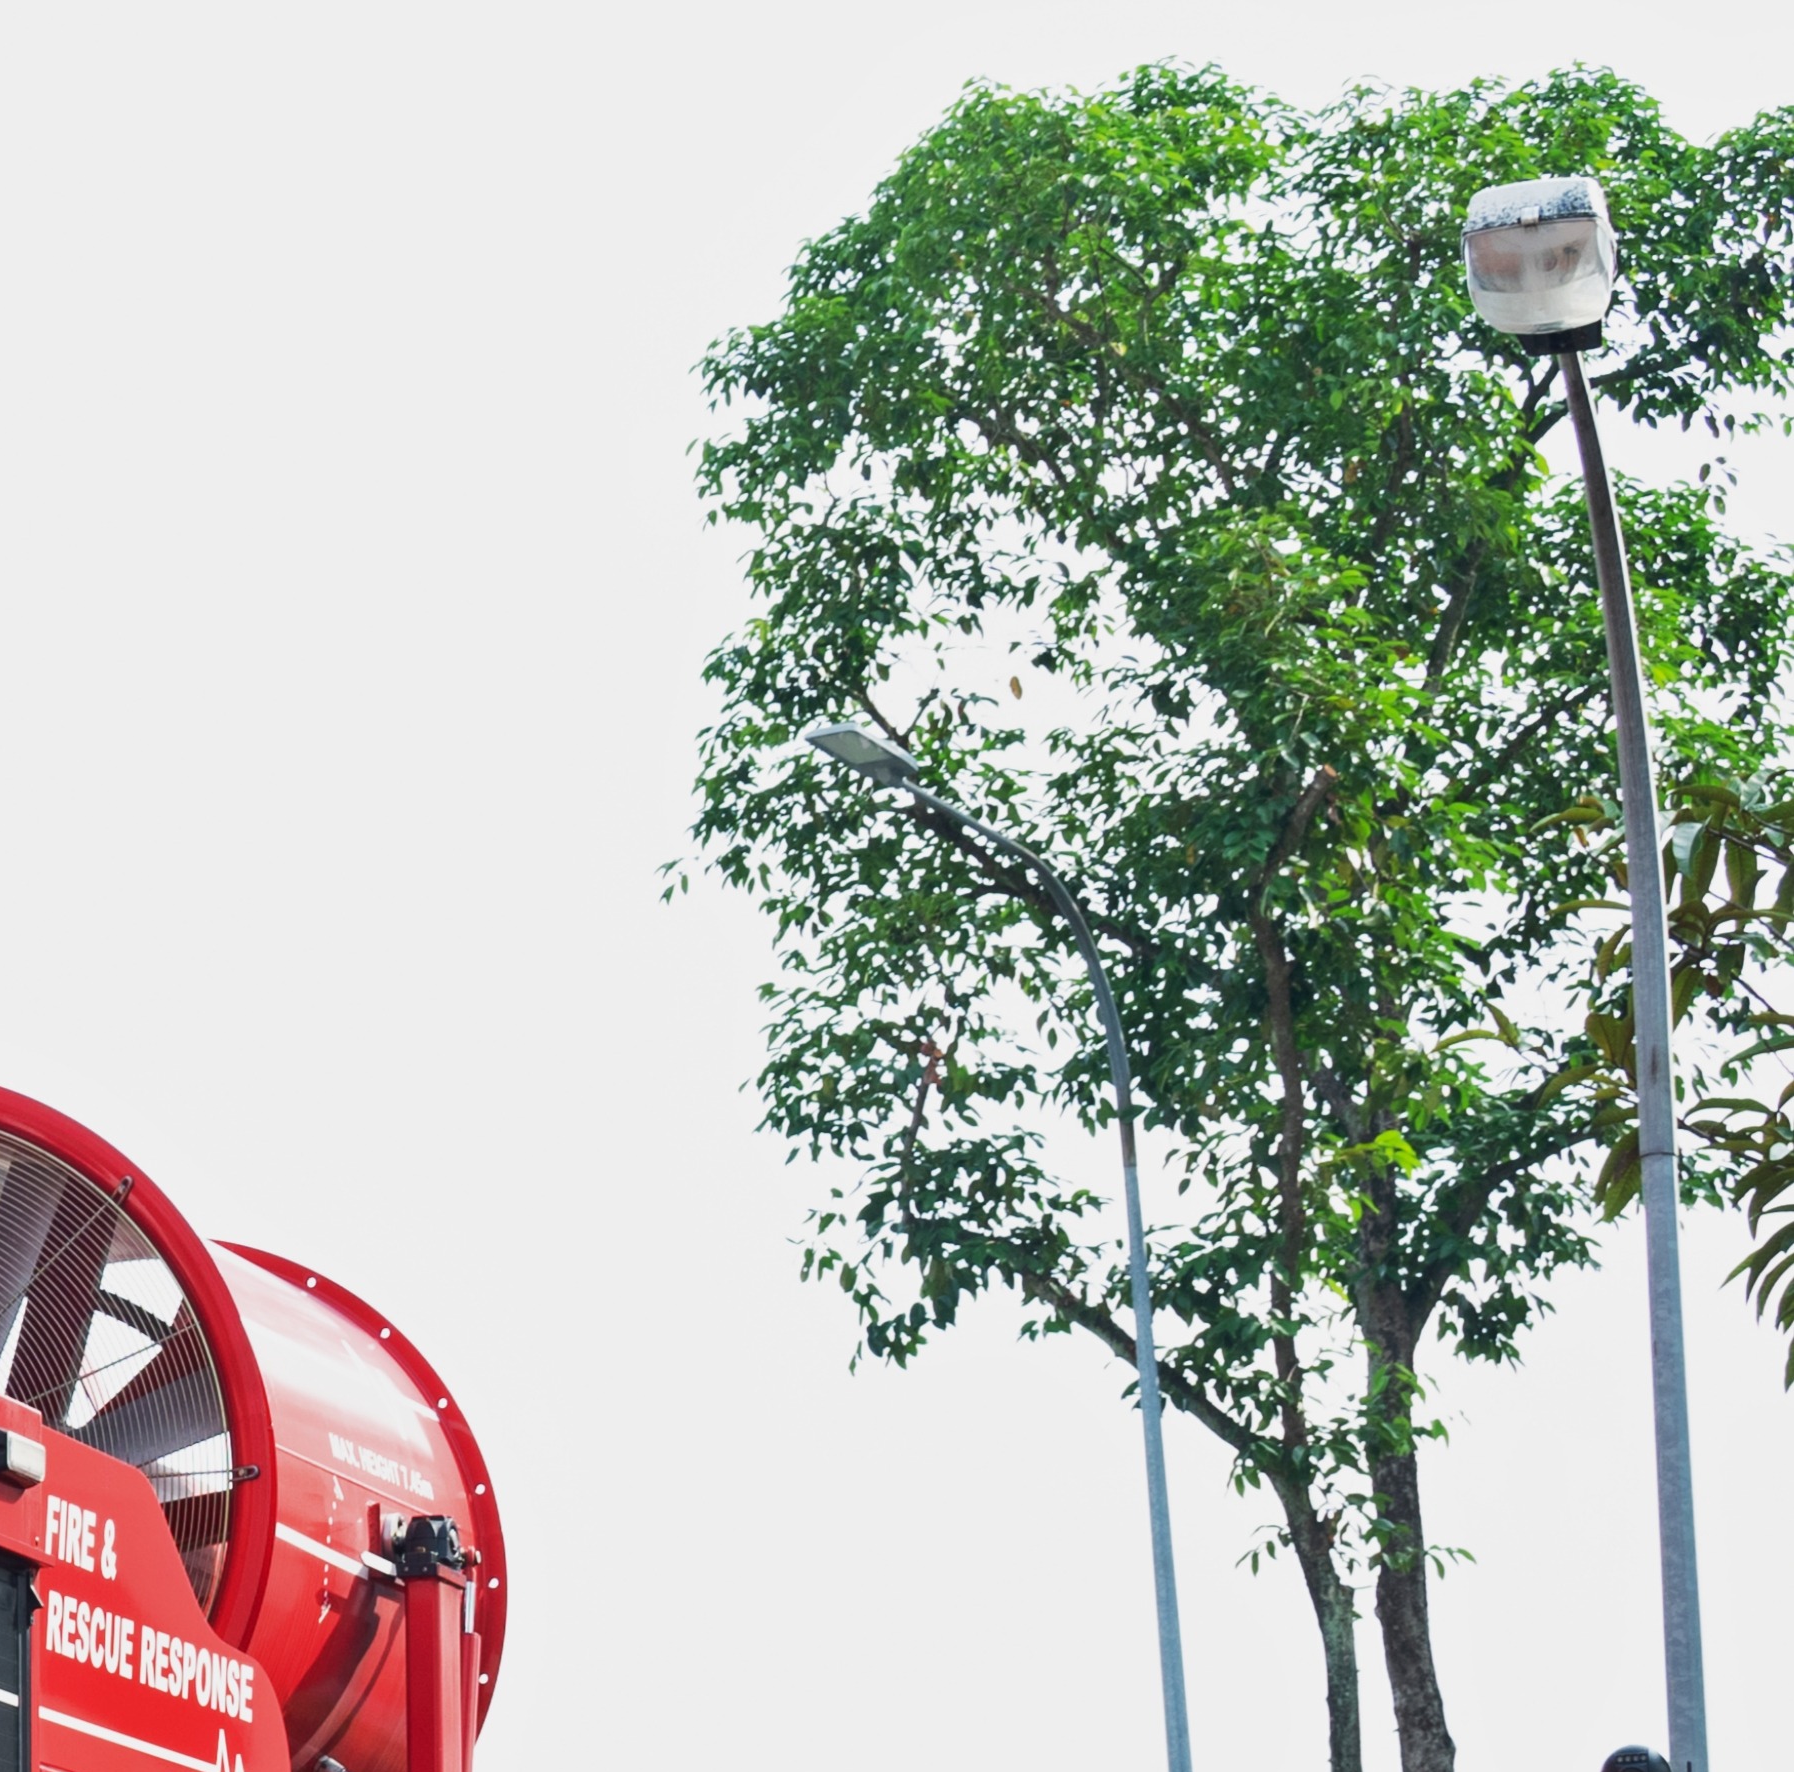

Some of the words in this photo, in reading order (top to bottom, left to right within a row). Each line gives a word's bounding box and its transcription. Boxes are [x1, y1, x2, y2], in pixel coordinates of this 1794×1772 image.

[358, 1446, 400, 1487] HEIGHT
[45, 1494, 97, 1573] FIRE
[101, 1518, 117, 1581] &
[45, 1590, 135, 1680] RESCUE
[139, 1625, 254, 1723] RESPONSE
